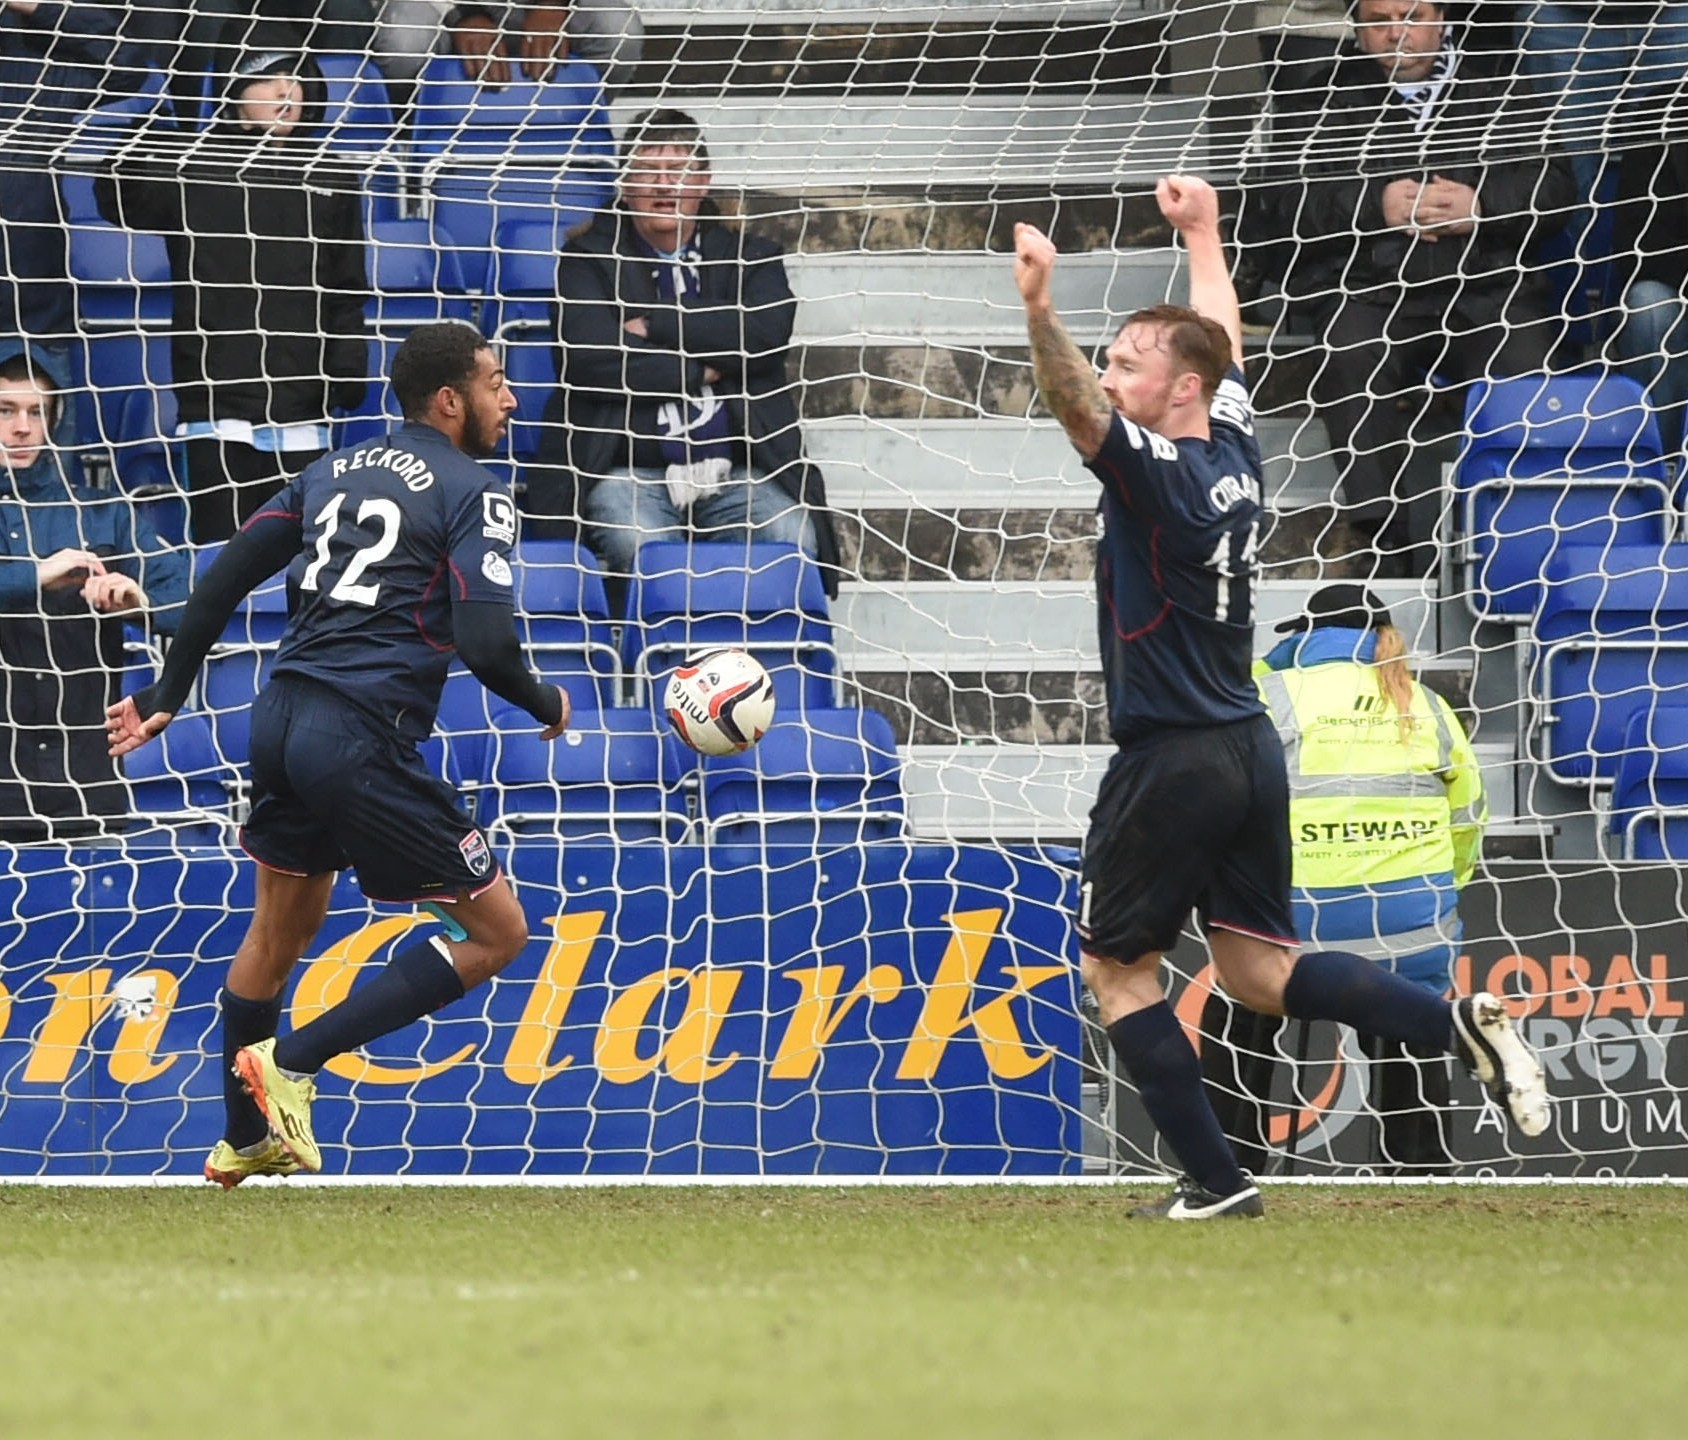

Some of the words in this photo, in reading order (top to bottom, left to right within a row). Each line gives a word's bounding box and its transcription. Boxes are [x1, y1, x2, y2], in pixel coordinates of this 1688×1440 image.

[332, 447, 434, 492] RECKORD
[300, 493, 400, 606] 12
[672, 681, 709, 724] mitre
[290, 908, 1071, 1085] Clark
[1442, 954, 1684, 1017] LOBAL
